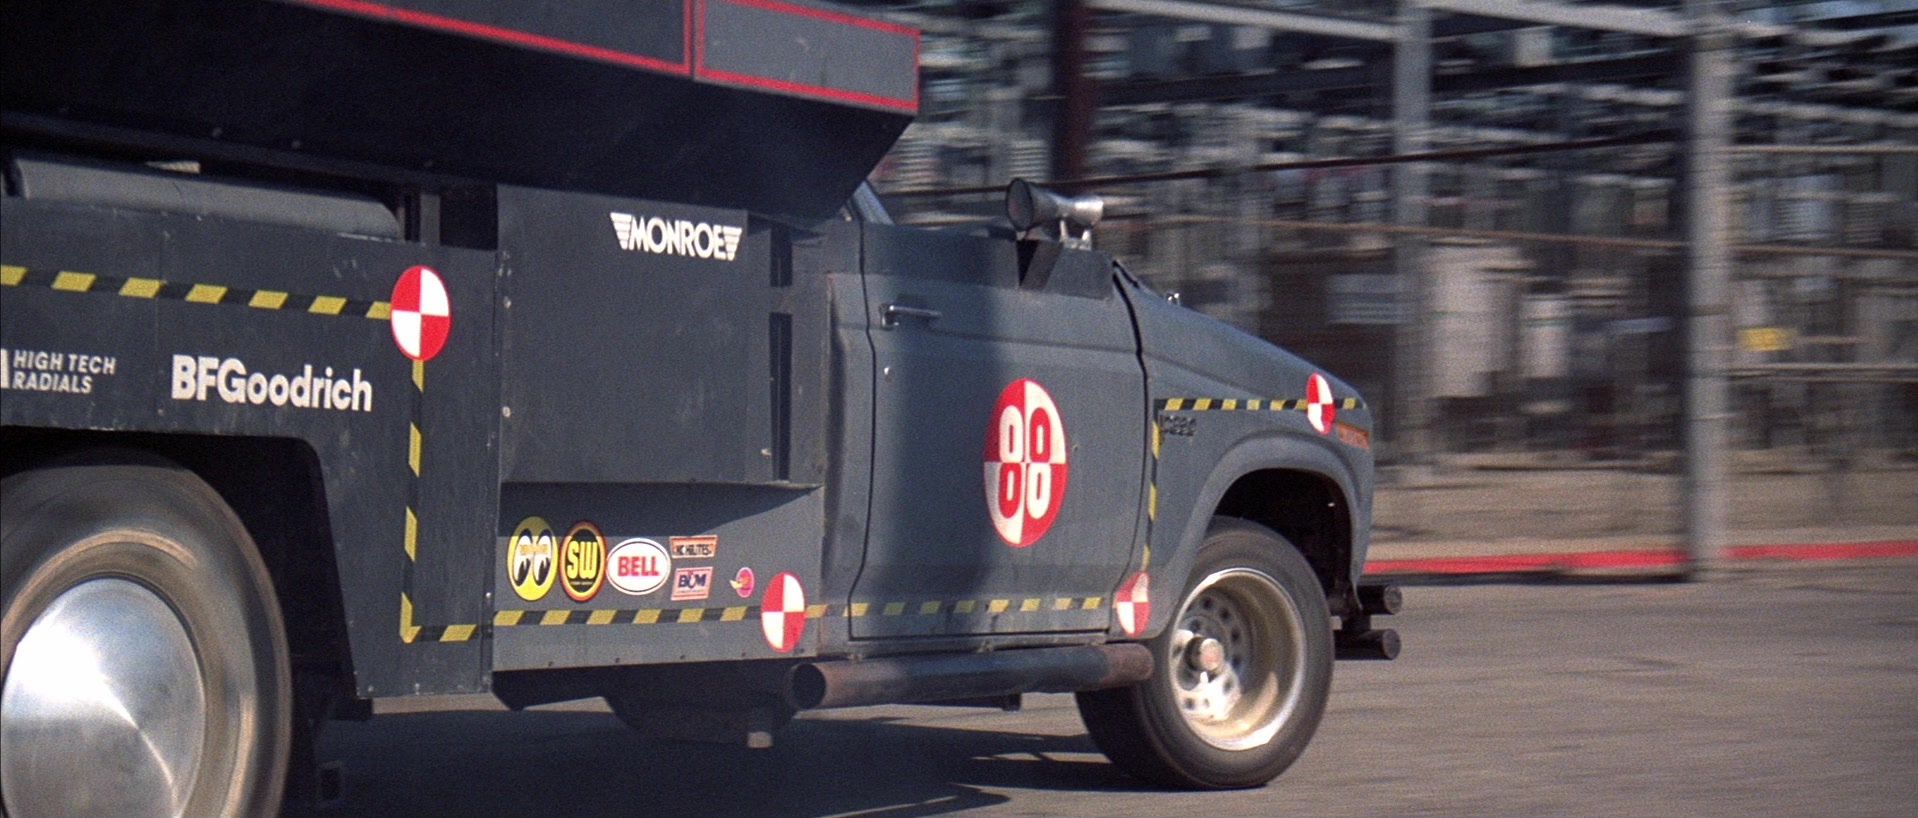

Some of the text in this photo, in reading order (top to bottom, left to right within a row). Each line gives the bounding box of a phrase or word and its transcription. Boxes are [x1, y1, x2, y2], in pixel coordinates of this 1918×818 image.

[628, 216, 727, 260] MONROE
[13, 349, 63, 371] HIGH
[68, 354, 116, 375] TECH
[12, 370, 93, 394] RADIALS
[171, 354, 372, 411] BFGoodrich
[998, 405, 1052, 519] 88
[566, 541, 598, 579] SW
[617, 556, 660, 577] BELL
